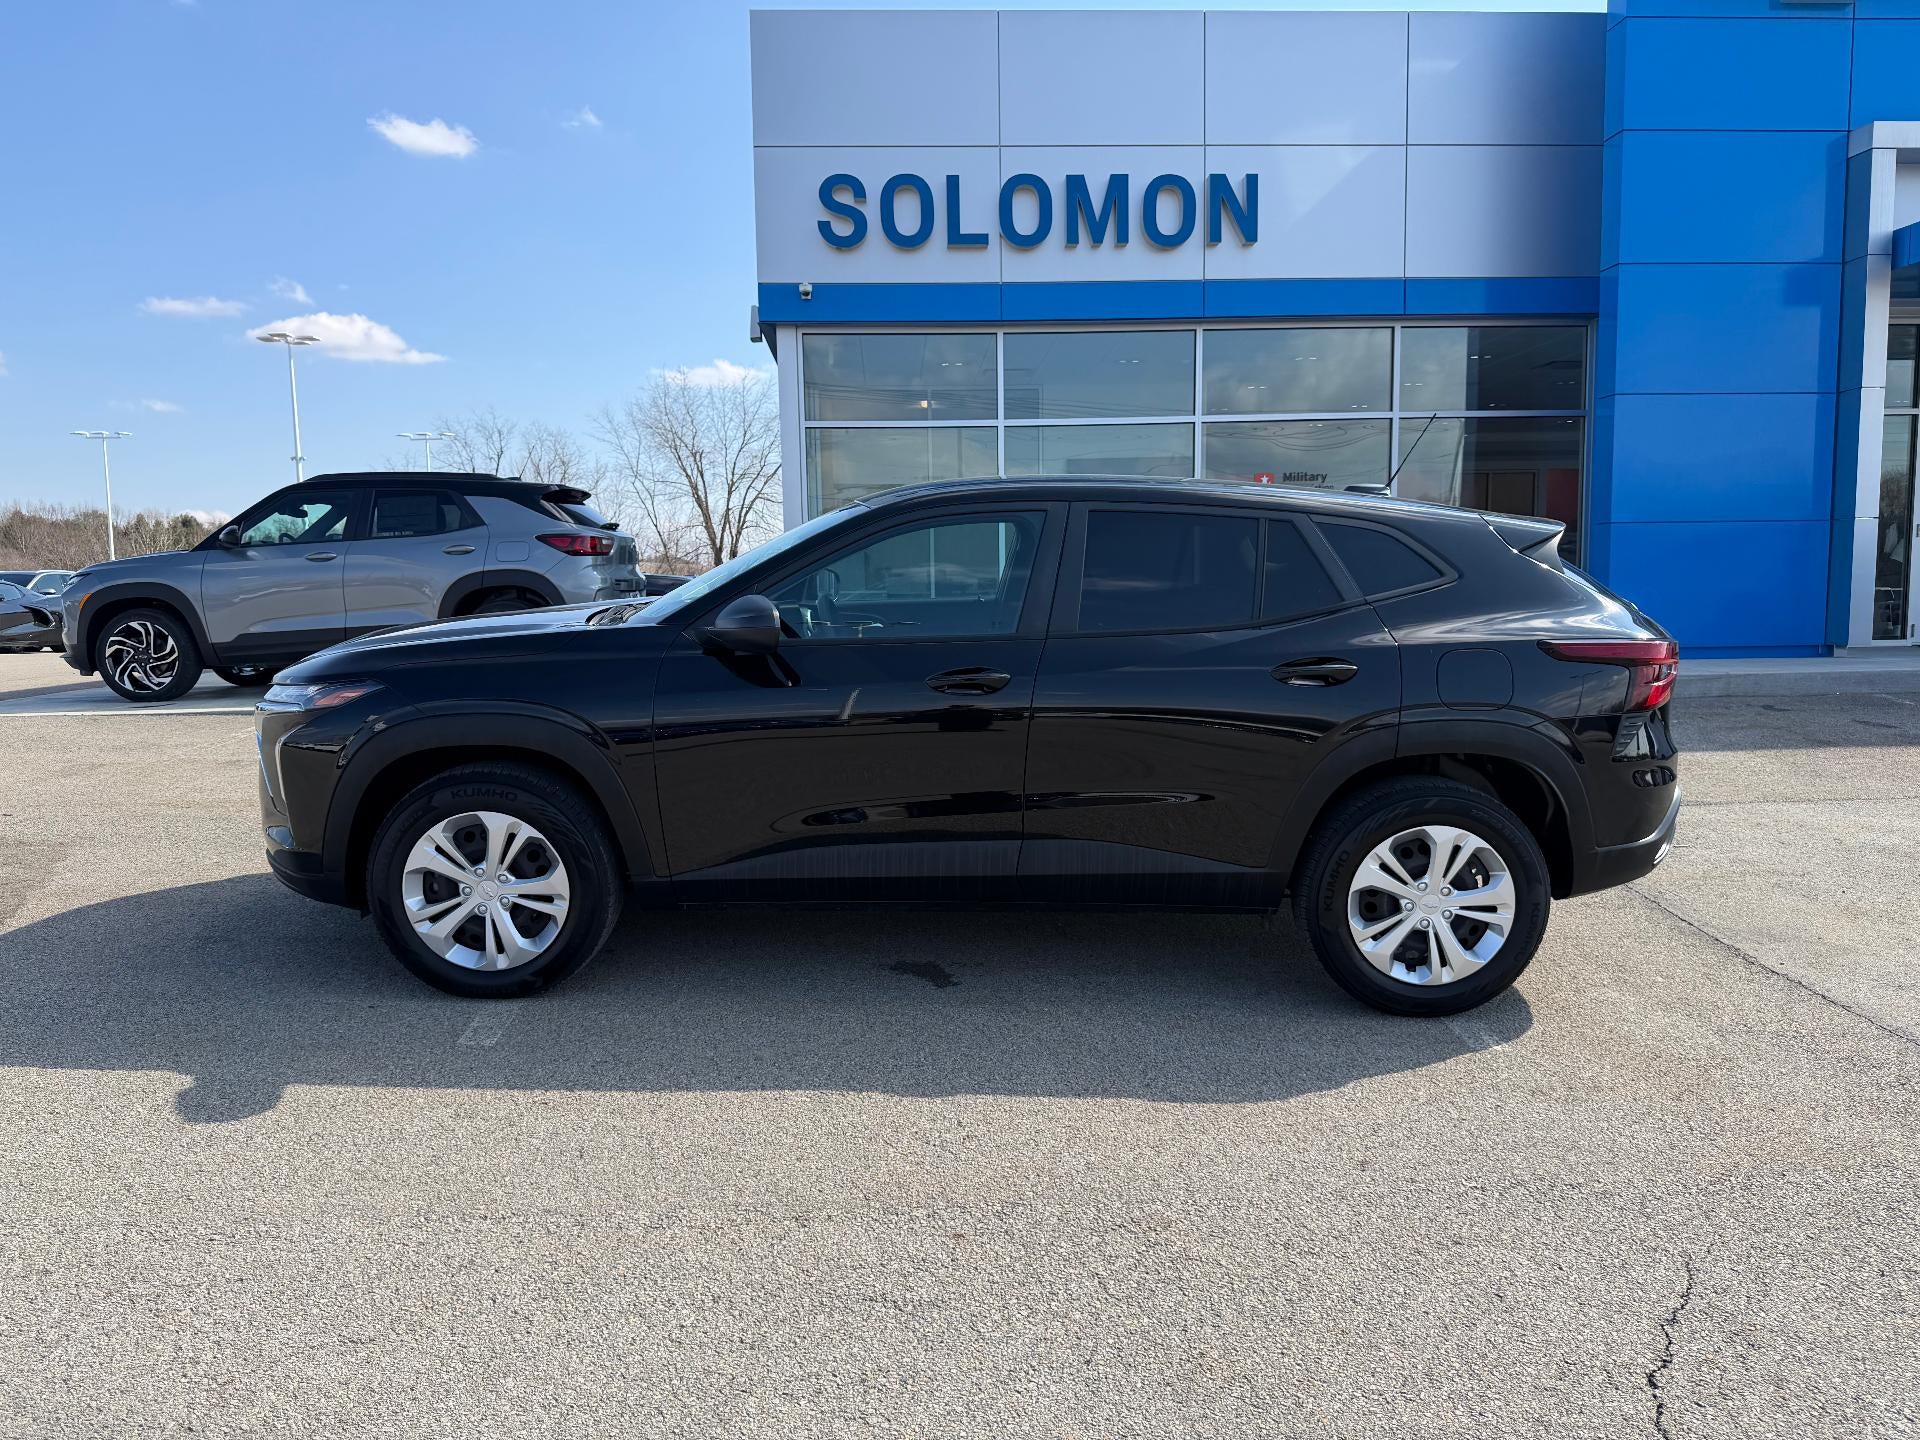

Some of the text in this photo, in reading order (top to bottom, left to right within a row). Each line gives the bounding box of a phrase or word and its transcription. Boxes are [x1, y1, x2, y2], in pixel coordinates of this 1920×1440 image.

[817, 173, 1259, 249] SOLOMON
[1283, 472, 1328, 483] Military
[451, 788, 517, 802] KUMHO
[1324, 850, 1350, 912] KUMHO
